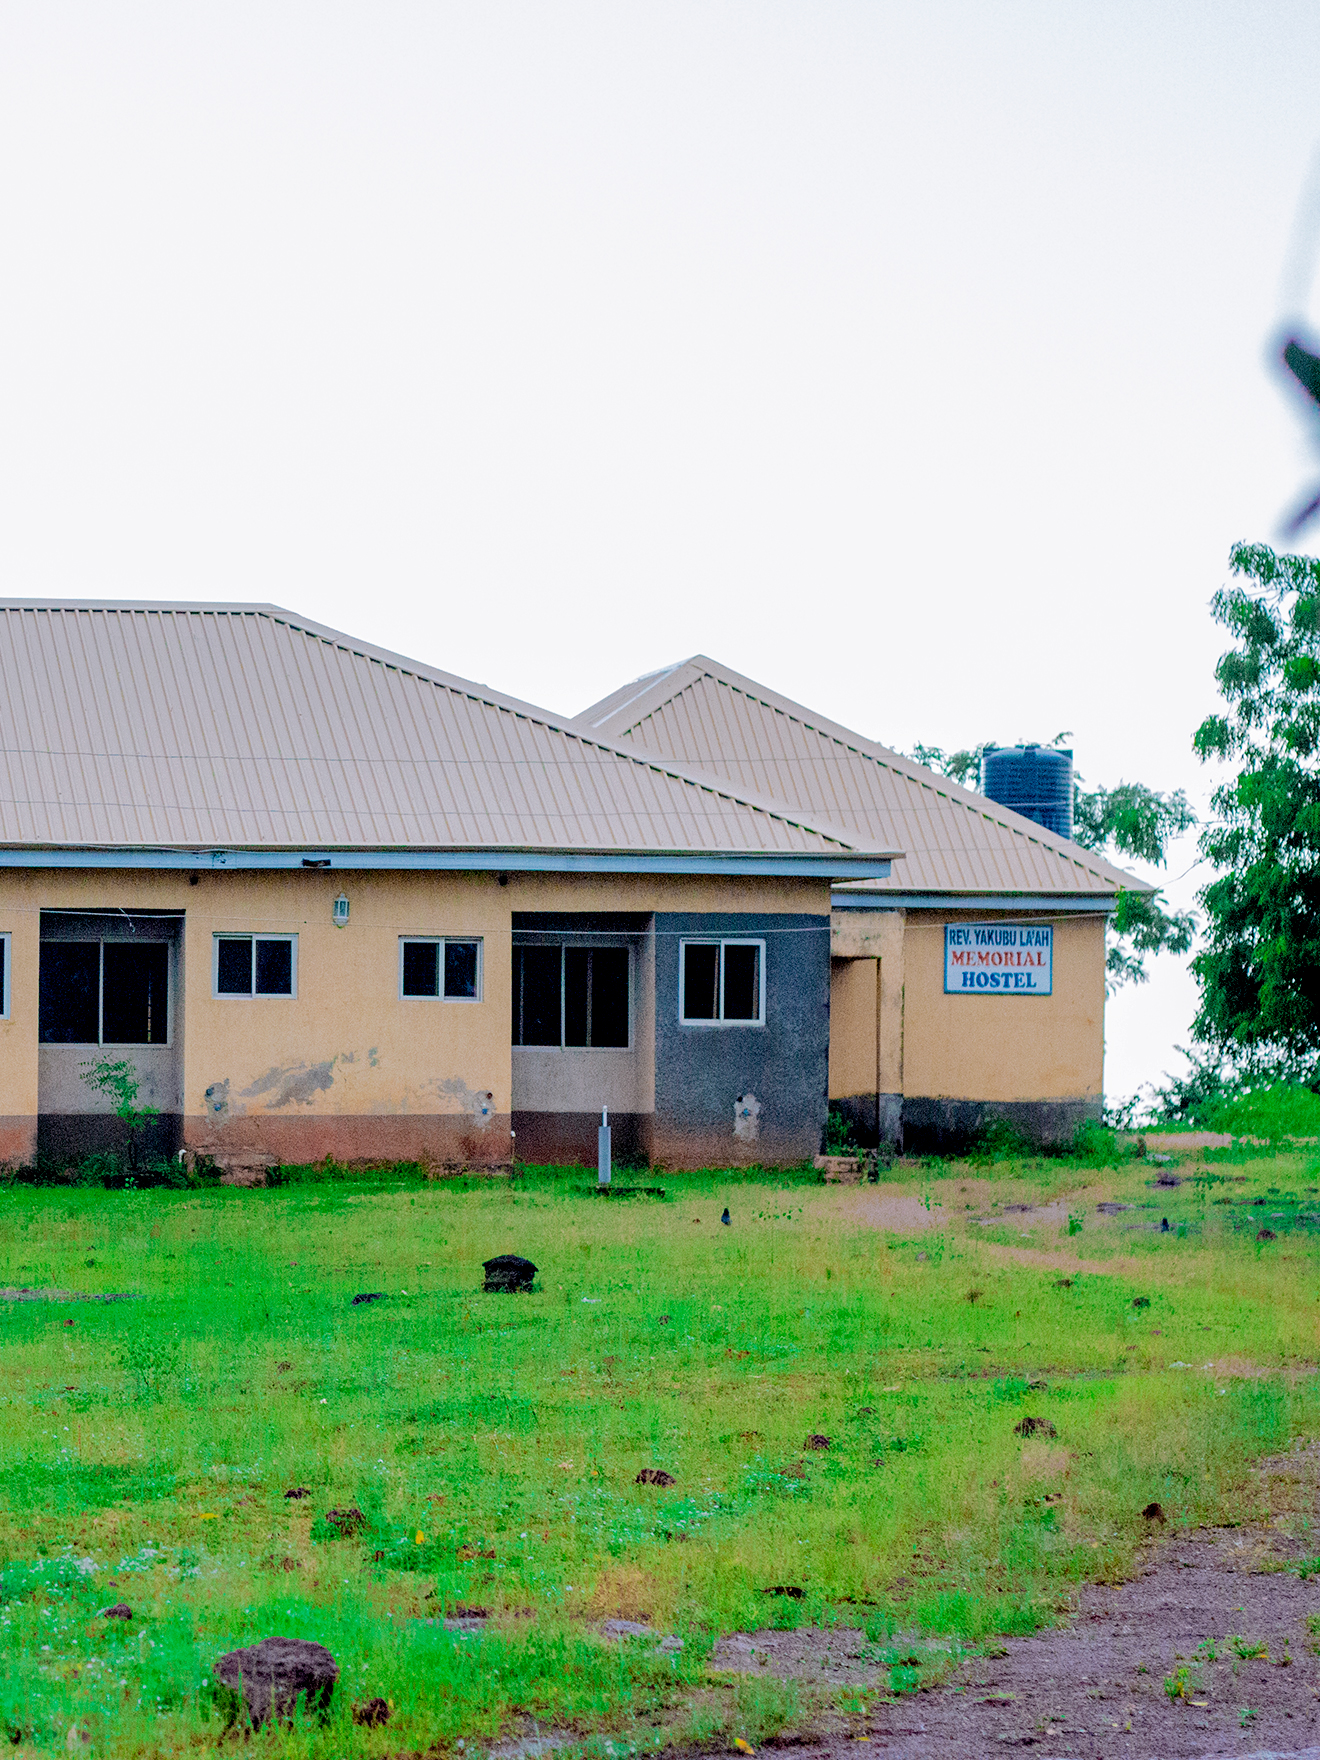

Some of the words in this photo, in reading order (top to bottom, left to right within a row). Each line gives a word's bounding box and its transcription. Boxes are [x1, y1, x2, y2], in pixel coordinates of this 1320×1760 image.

[949, 929, 971, 945] REV.
[974, 929, 1017, 946] YAKUBU
[1020, 930, 1049, 946] LA'AH
[951, 951, 1046, 966] MEMORIAL
[962, 971, 1037, 988] HOSTEL
